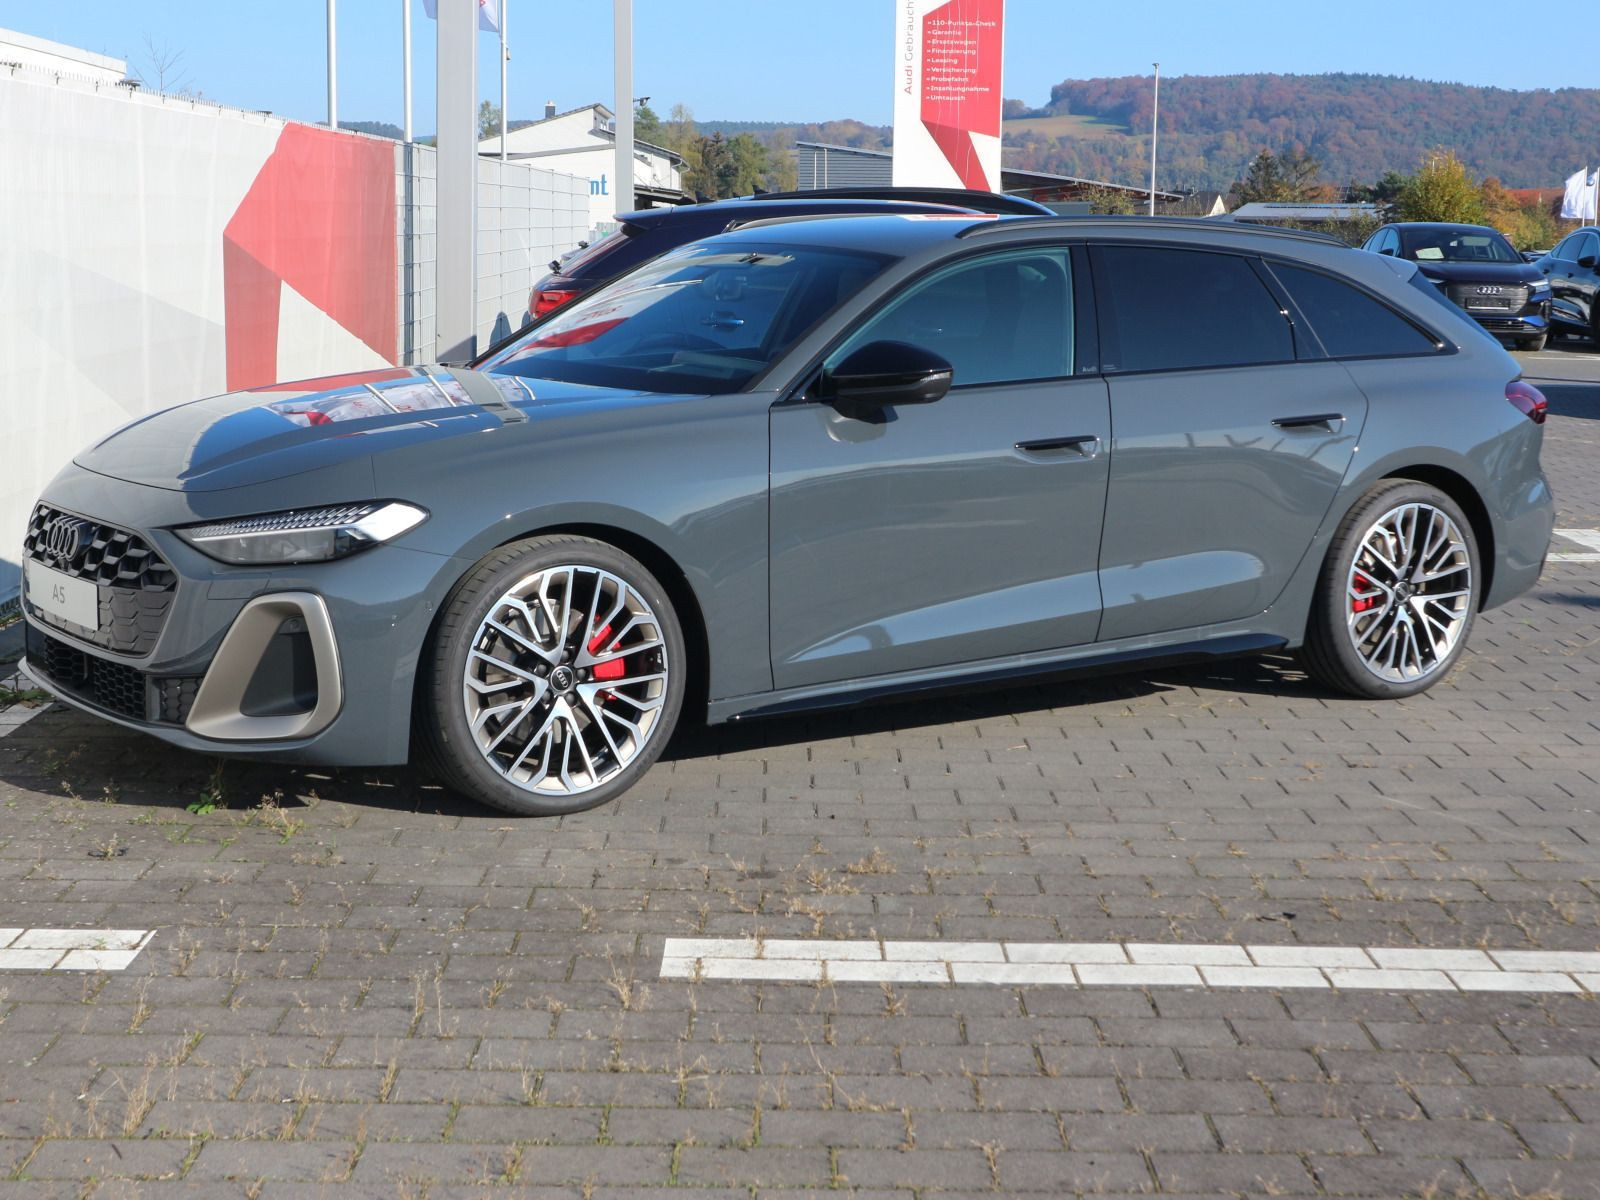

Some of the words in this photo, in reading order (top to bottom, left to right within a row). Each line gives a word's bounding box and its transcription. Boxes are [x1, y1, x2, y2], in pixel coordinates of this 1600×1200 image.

[904, 0, 914, 62] Gebrauch
[904, 65, 913, 95] Audi
[52, 584, 66, 604] A5
